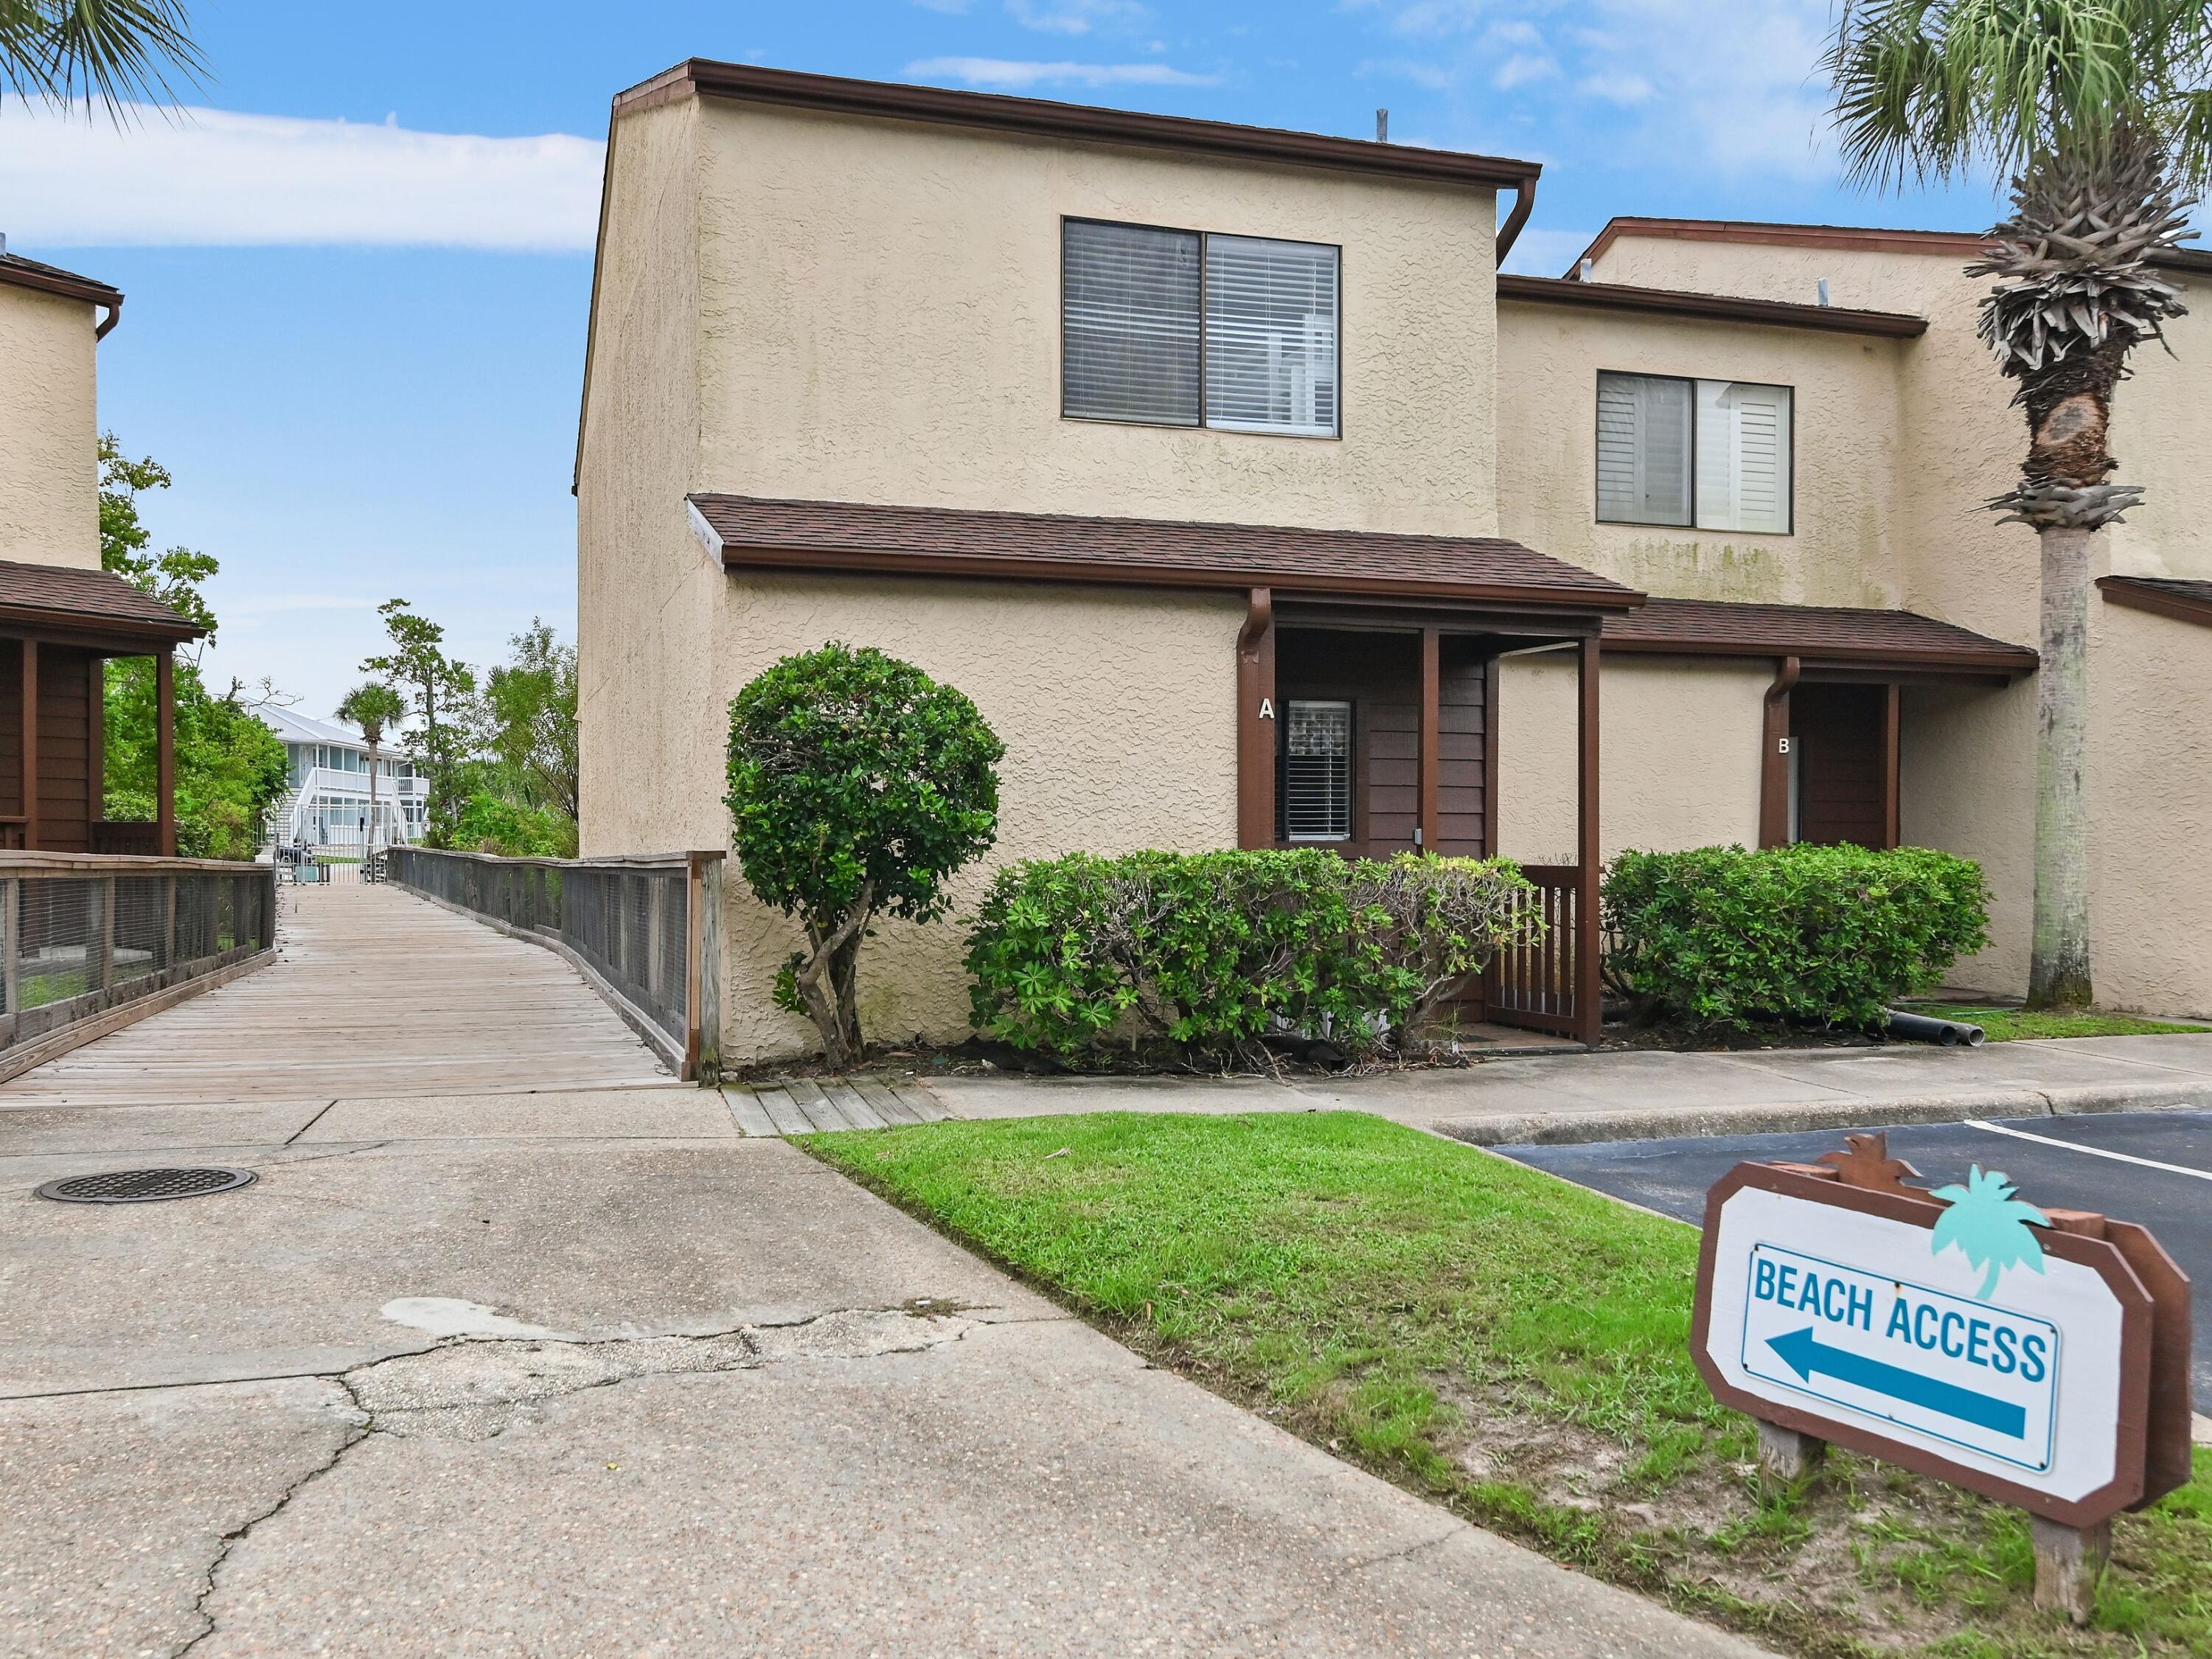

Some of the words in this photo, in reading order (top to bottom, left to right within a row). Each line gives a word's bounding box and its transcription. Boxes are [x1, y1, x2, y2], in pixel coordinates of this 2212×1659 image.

[1259, 698, 1275, 719] A
[1778, 738, 1790, 754] B
[1755, 1258, 1874, 1332] BEACH
[1886, 1297, 2047, 1383] ACCESS
